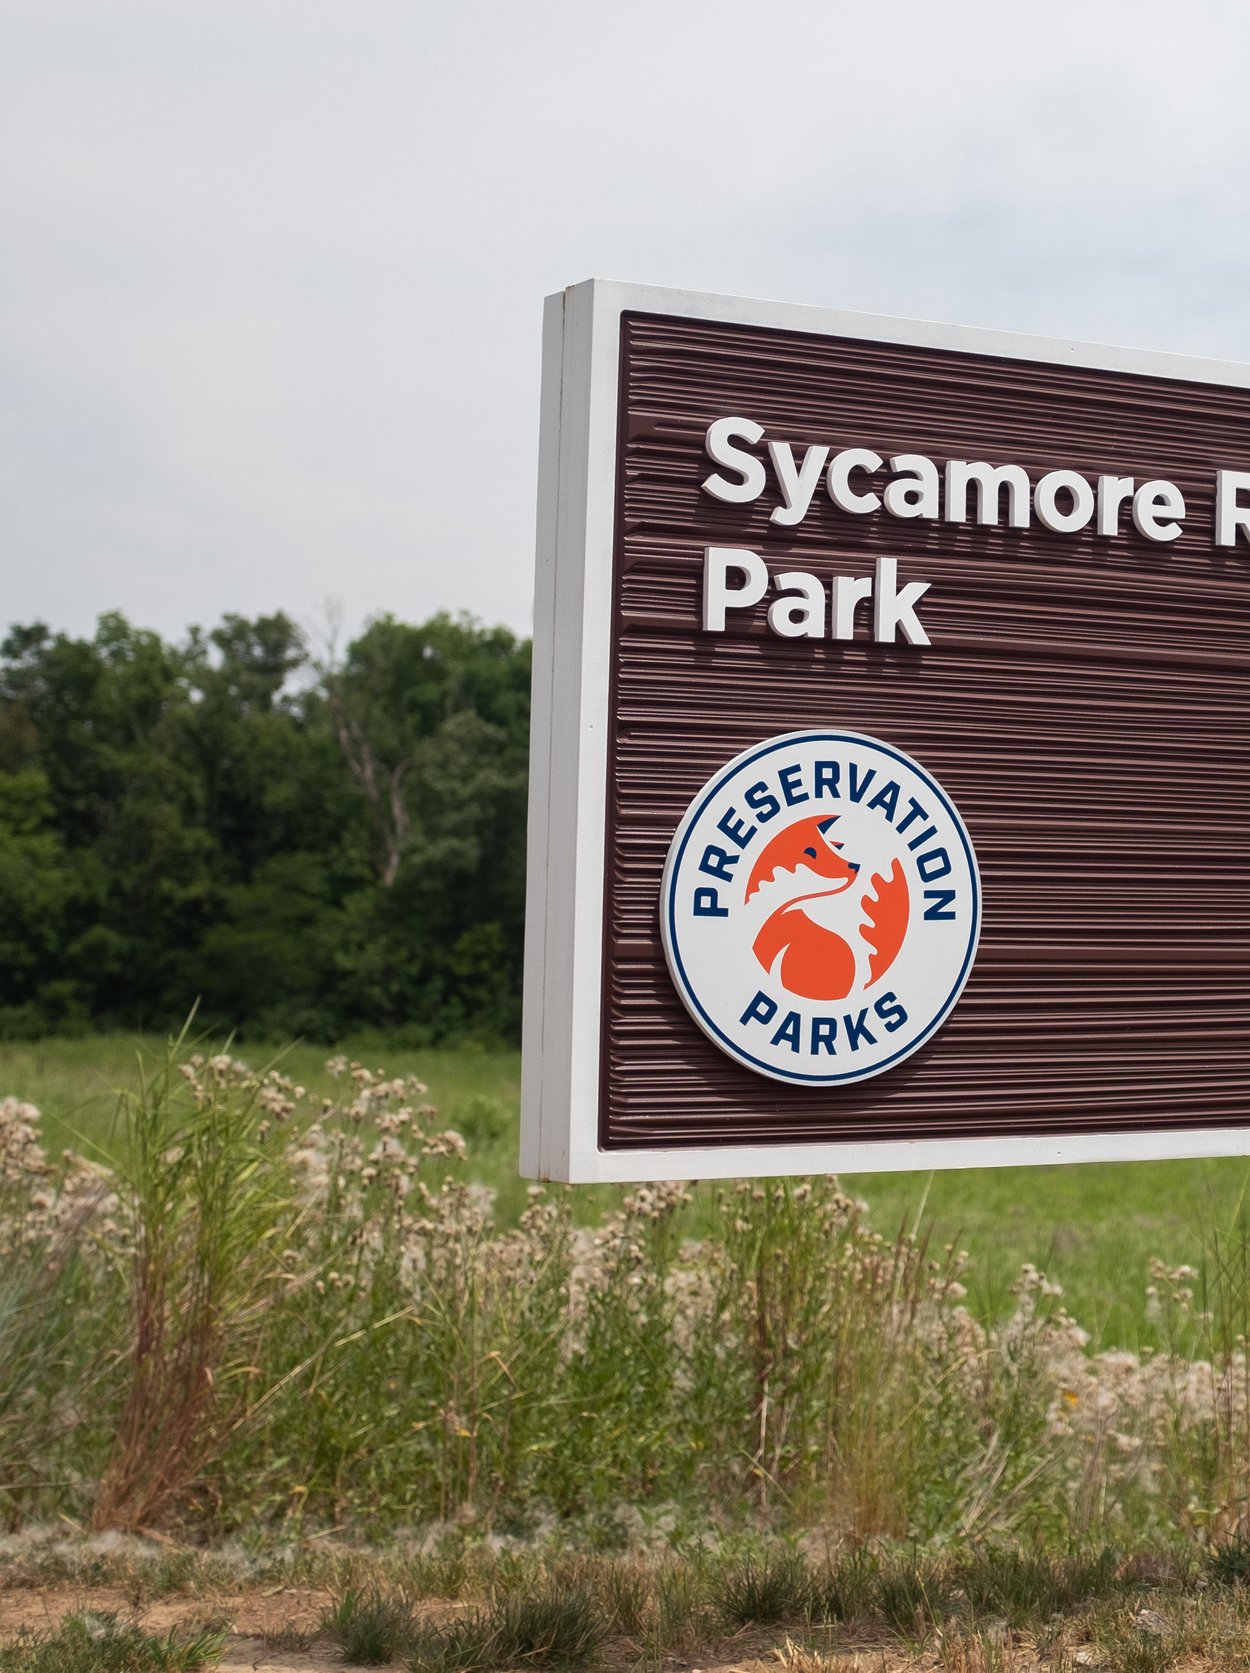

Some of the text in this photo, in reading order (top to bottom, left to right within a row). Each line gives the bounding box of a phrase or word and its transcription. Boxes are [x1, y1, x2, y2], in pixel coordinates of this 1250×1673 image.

[701, 416, 1186, 542] Sycamore
[703, 546, 932, 646] Park
[692, 760, 957, 921] PRESERVATION
[738, 990, 909, 1056] PARKS
